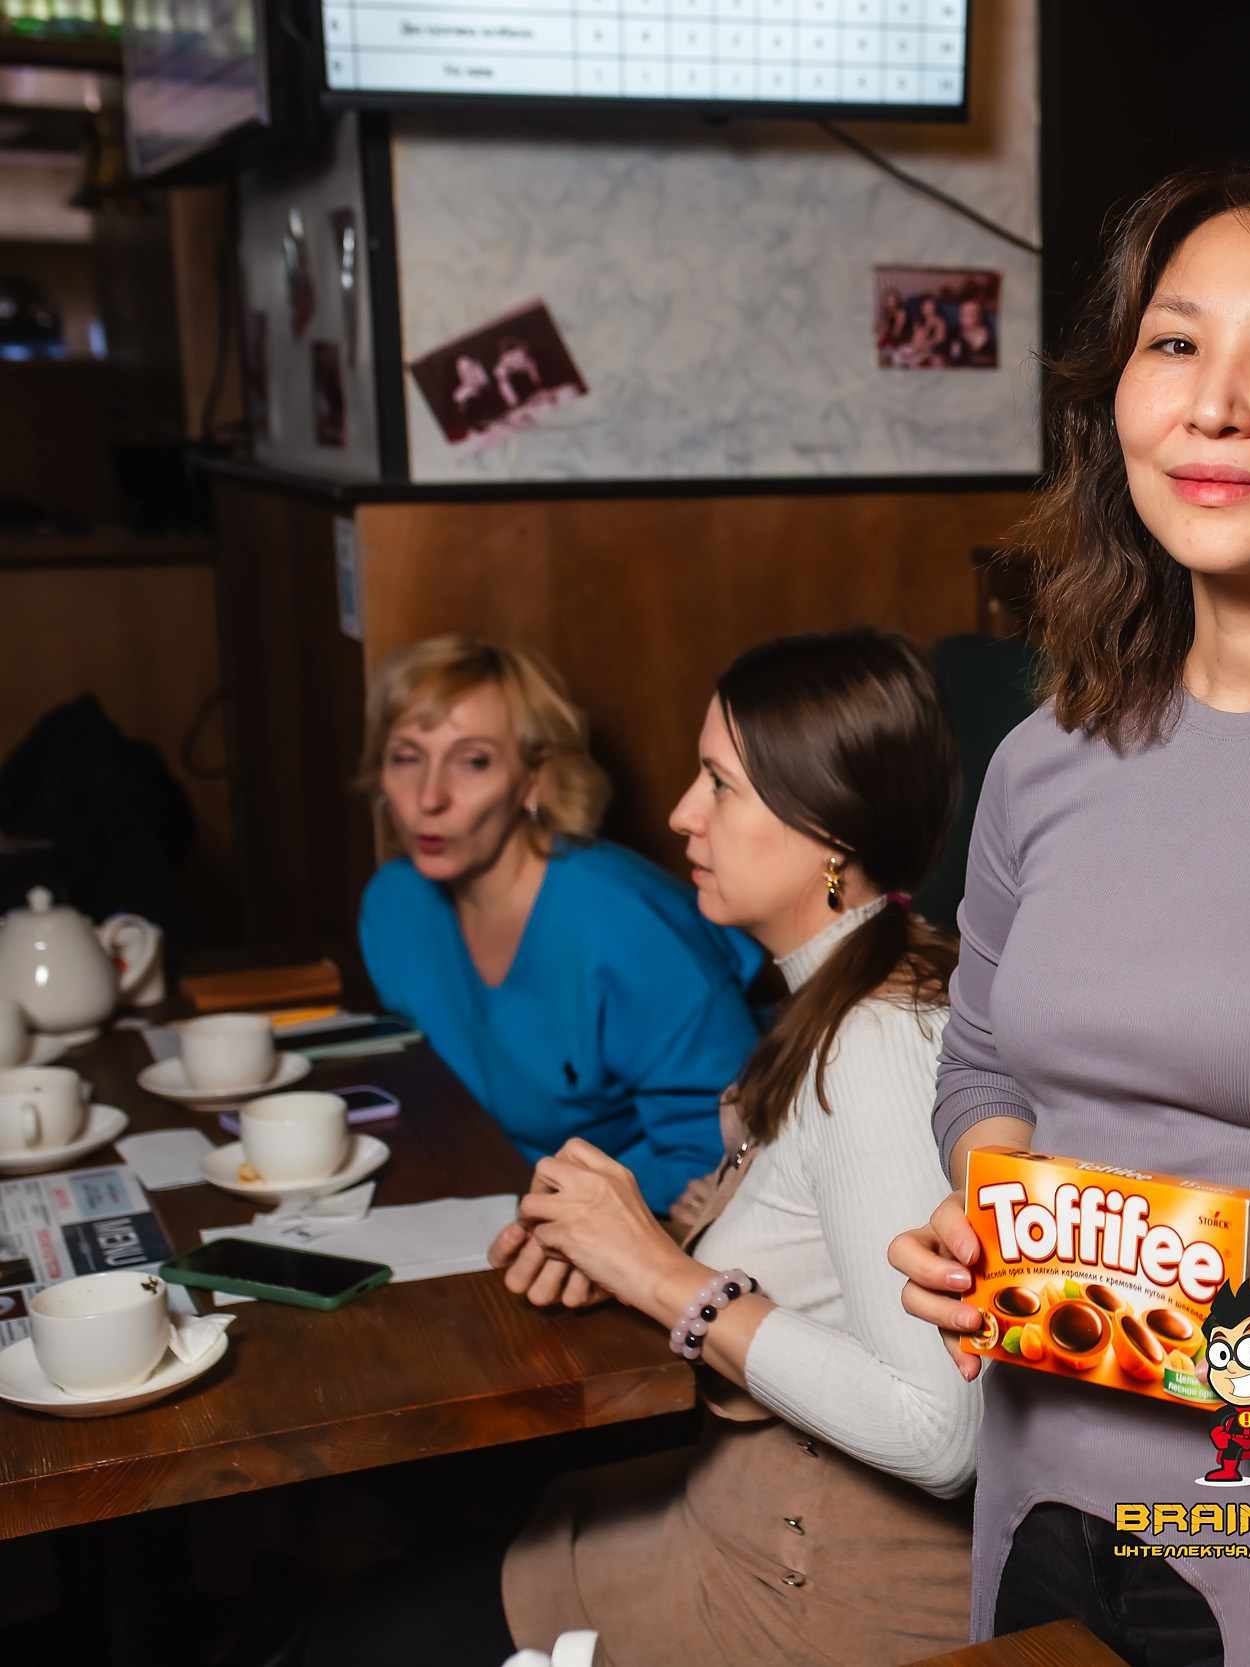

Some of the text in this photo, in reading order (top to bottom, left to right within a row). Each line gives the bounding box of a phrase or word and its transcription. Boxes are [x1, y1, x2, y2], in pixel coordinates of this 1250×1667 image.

[93, 1217, 148, 1266] MENU
[978, 1181, 1225, 1302] Toffifee
[1198, 1216, 1229, 1230] STORCK
[1008, 1267, 1024, 1277] орех
[1026, 1267, 1031, 1275] в
[1033, 1266, 1059, 1276] мягкой
[1061, 1269, 1098, 1281] карамели
[1105, 1276, 1143, 1293] кремовой
[1144, 1288, 1166, 1300] нугой
